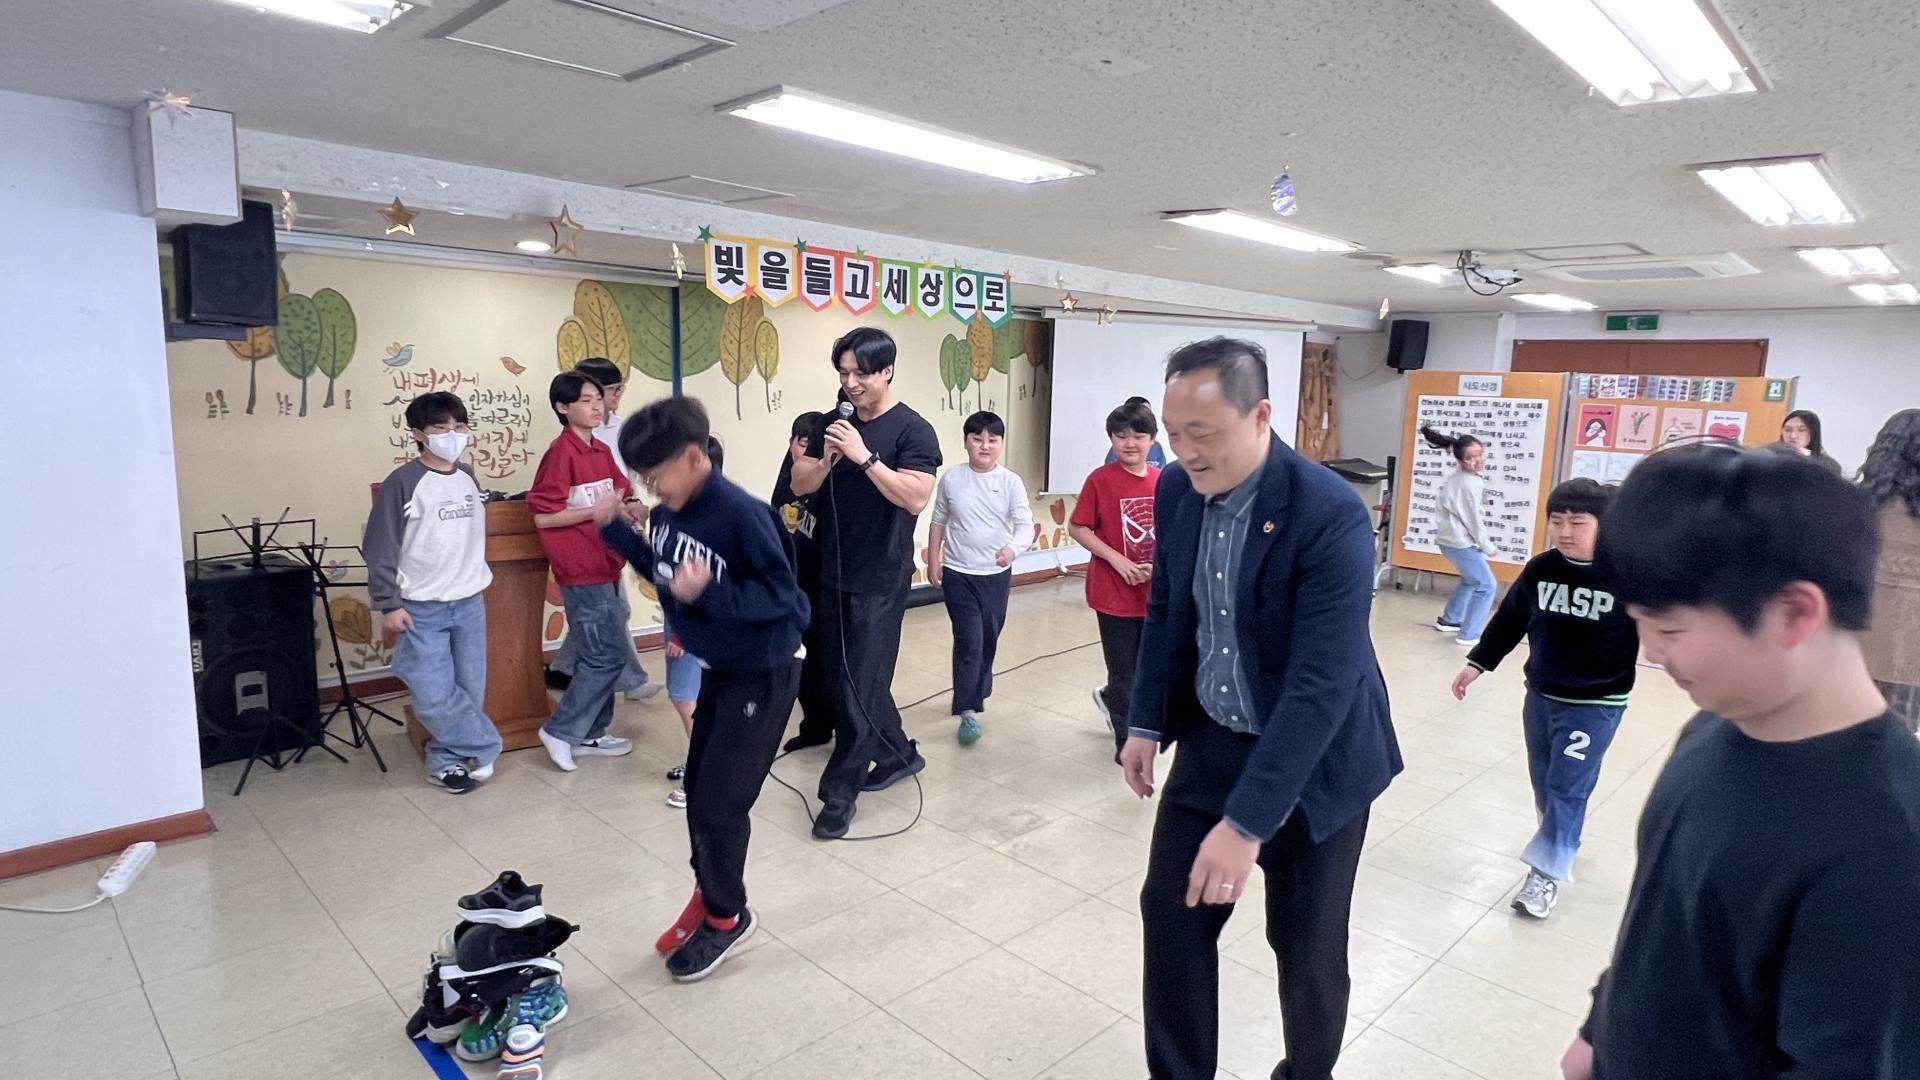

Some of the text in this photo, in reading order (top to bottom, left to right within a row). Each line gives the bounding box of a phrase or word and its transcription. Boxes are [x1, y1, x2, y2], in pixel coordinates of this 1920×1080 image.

[713, 244, 1006, 313] 빛을 들고 세상으로
[1462, 381, 1498, 392] 사도신경
[1537, 581, 1615, 621] VASP
[1563, 730, 1591, 761] 2
